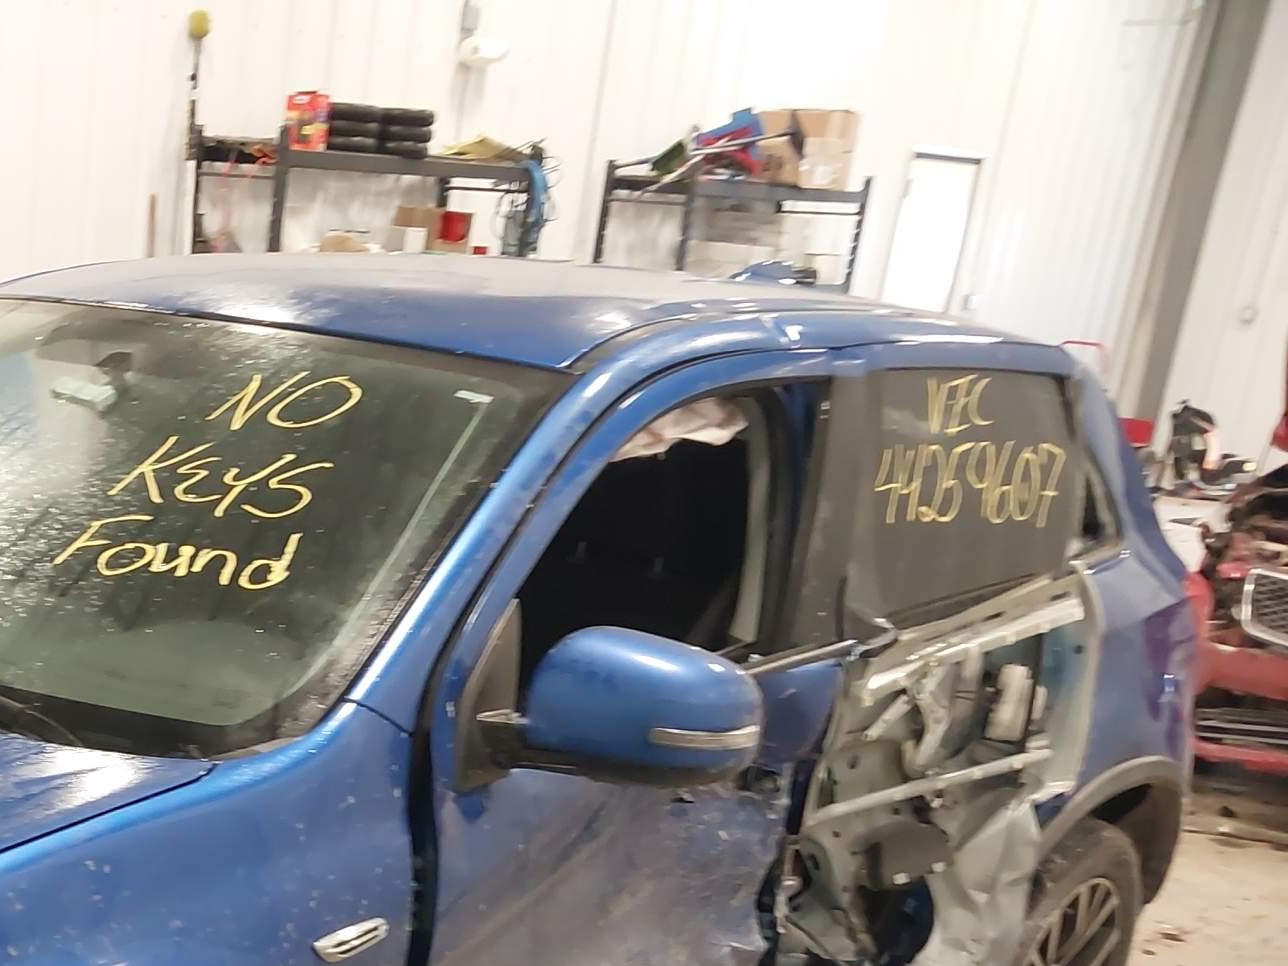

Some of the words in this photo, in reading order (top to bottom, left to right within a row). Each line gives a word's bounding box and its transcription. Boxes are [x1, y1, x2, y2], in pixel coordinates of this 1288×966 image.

[205, 371, 364, 431] NO
[107, 435, 335, 518] KEYS
[873, 440, 1067, 528] 44259607
[51, 514, 304, 590] Found
